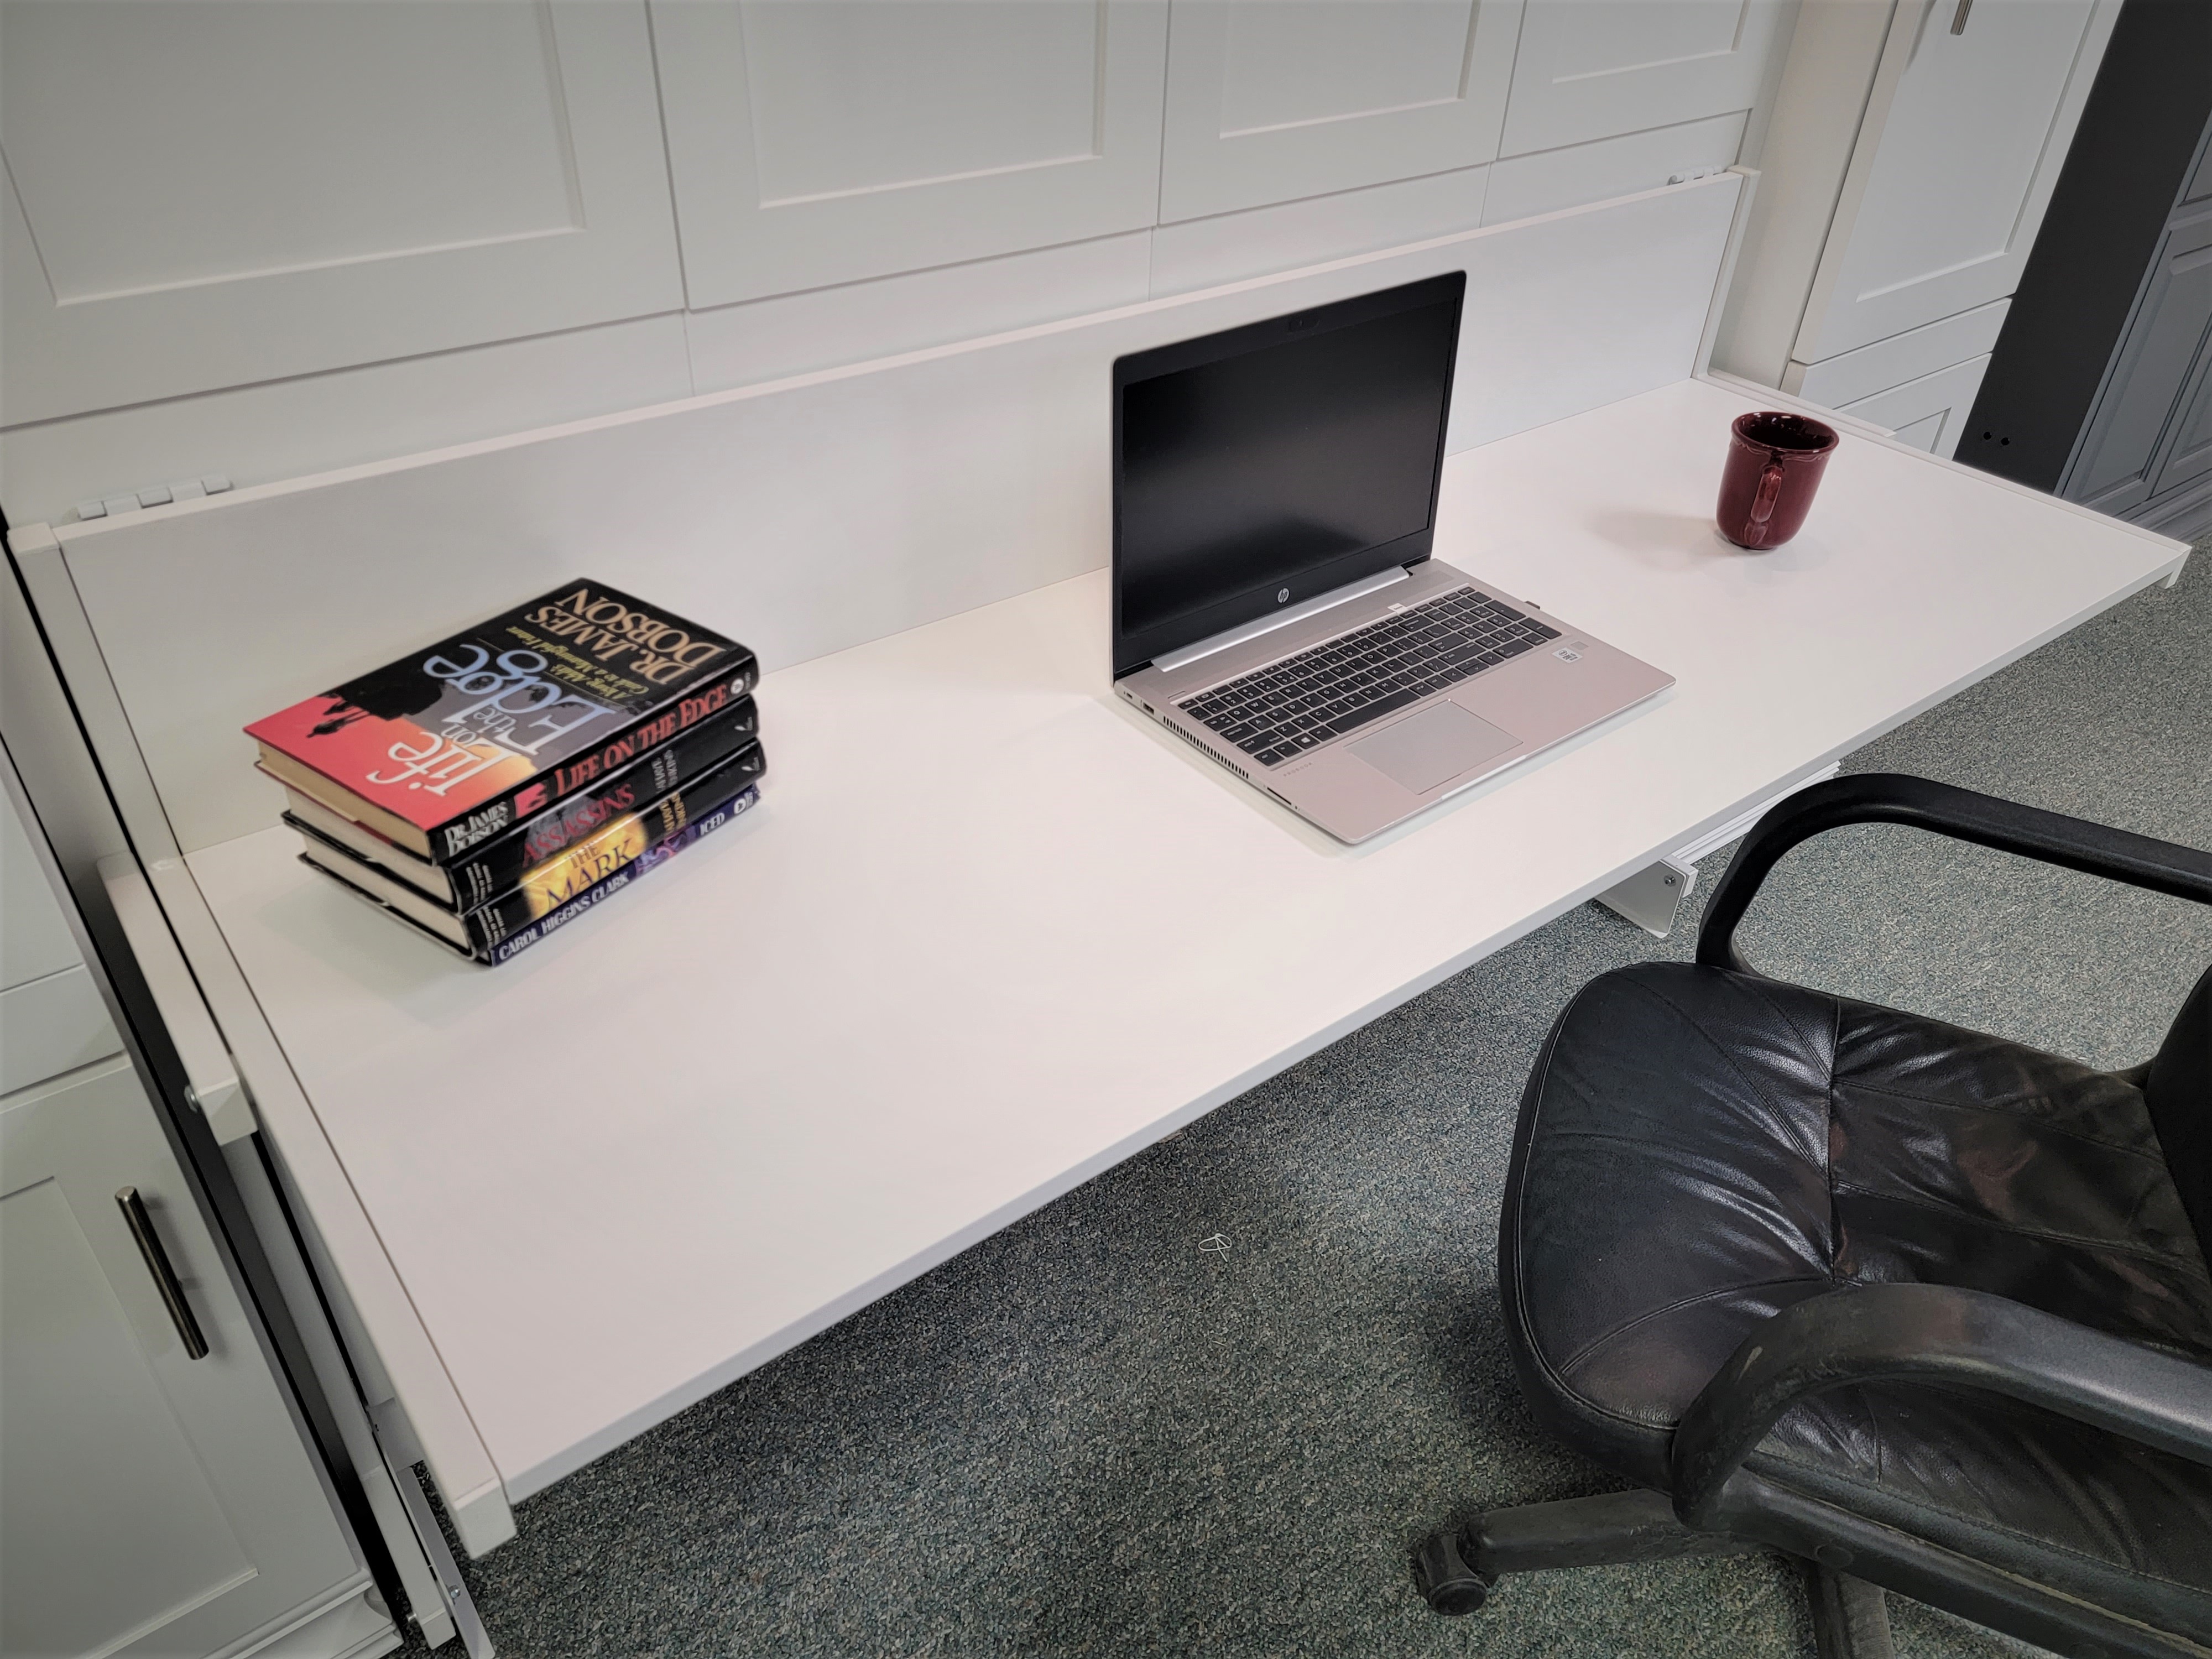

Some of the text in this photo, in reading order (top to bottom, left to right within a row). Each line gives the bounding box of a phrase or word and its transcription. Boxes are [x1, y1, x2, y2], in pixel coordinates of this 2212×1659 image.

[555, 588, 724, 668] DOBSON
[1277, 588, 1289, 603] hp
[525, 606, 695, 685] DR. JAMES
[422, 644, 617, 756] Edge
[441, 723, 476, 744] on
[473, 707, 517, 734] the
[366, 732, 525, 797] Life
[555, 684, 728, 797] LIFE ON THE EDGE
[468, 802, 508, 831] JAMES
[523, 783, 635, 868] ASSASSINS
[699, 812, 726, 837] ICED
[546, 837, 633, 907] MARK
[569, 844, 602, 869] THE
[498, 927, 540, 961] CAROL
[541, 895, 591, 935] HIGGINS
[591, 872, 629, 904] CLARK
